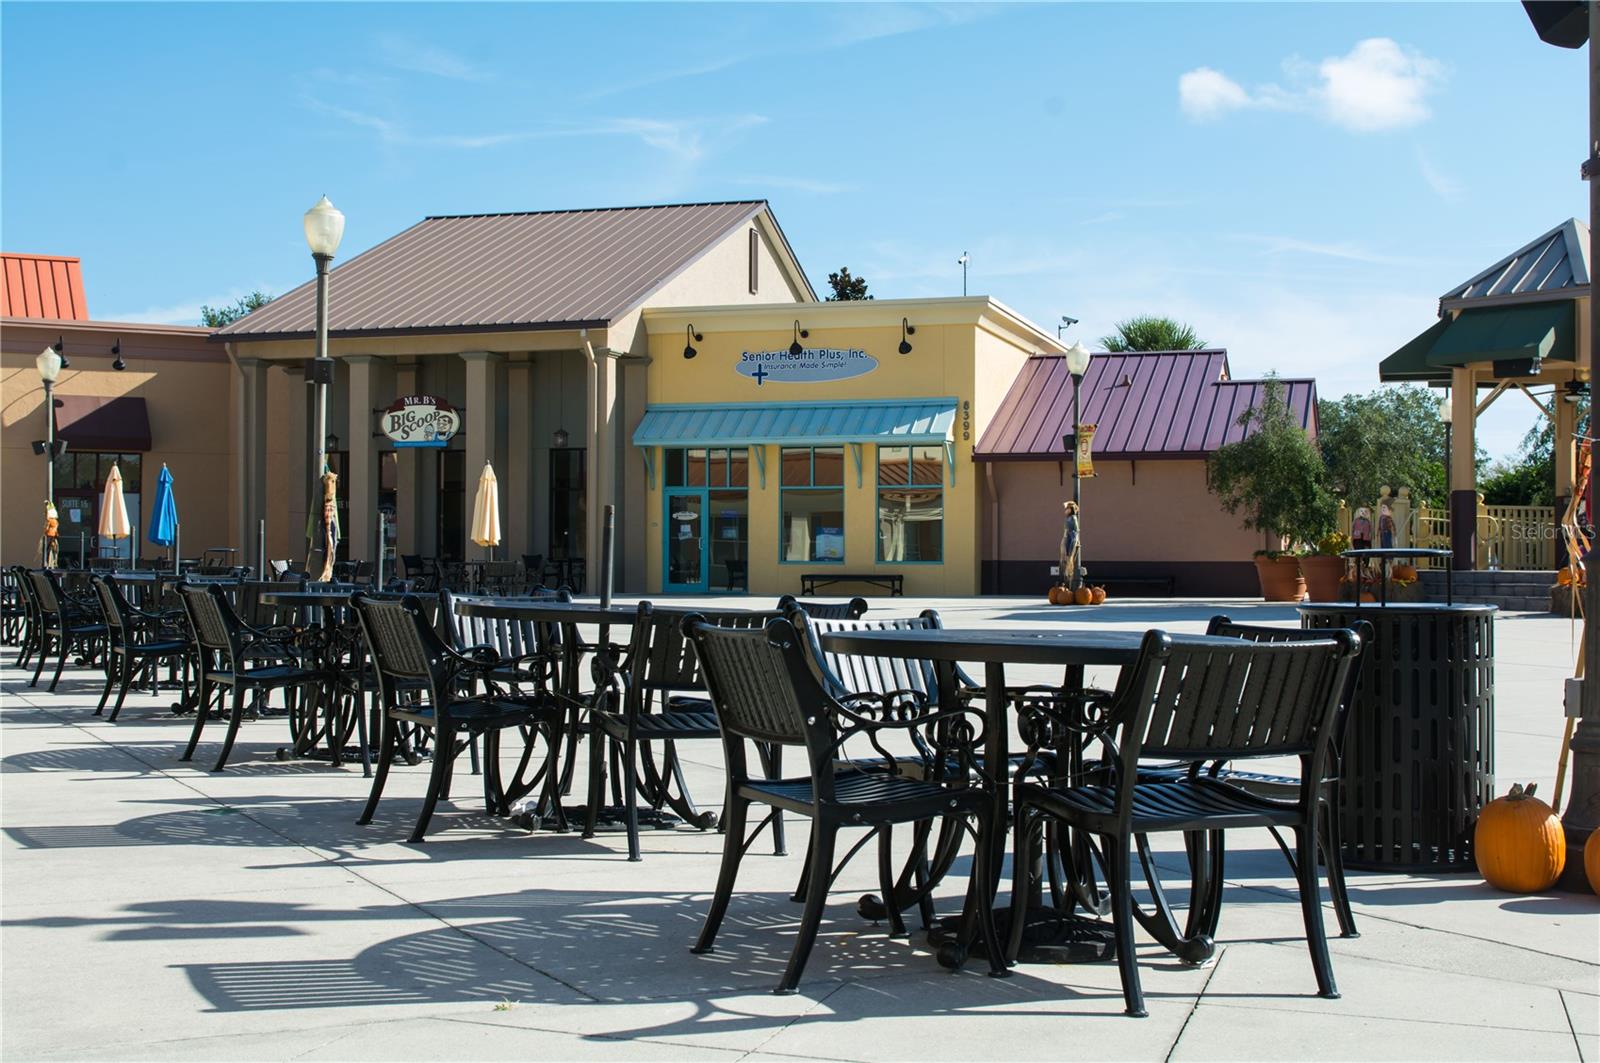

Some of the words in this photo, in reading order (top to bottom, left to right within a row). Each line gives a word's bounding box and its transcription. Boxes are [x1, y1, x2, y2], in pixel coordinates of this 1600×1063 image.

[742, 351, 776, 361] Senior
[779, 349, 814, 361] Health
[819, 349, 844, 360] Plus,
[848, 349, 868, 359] Inc.
[763, 362, 797, 370] Insurance
[388, 410, 416, 434] BIG
[400, 411, 441, 440] SCOOP
